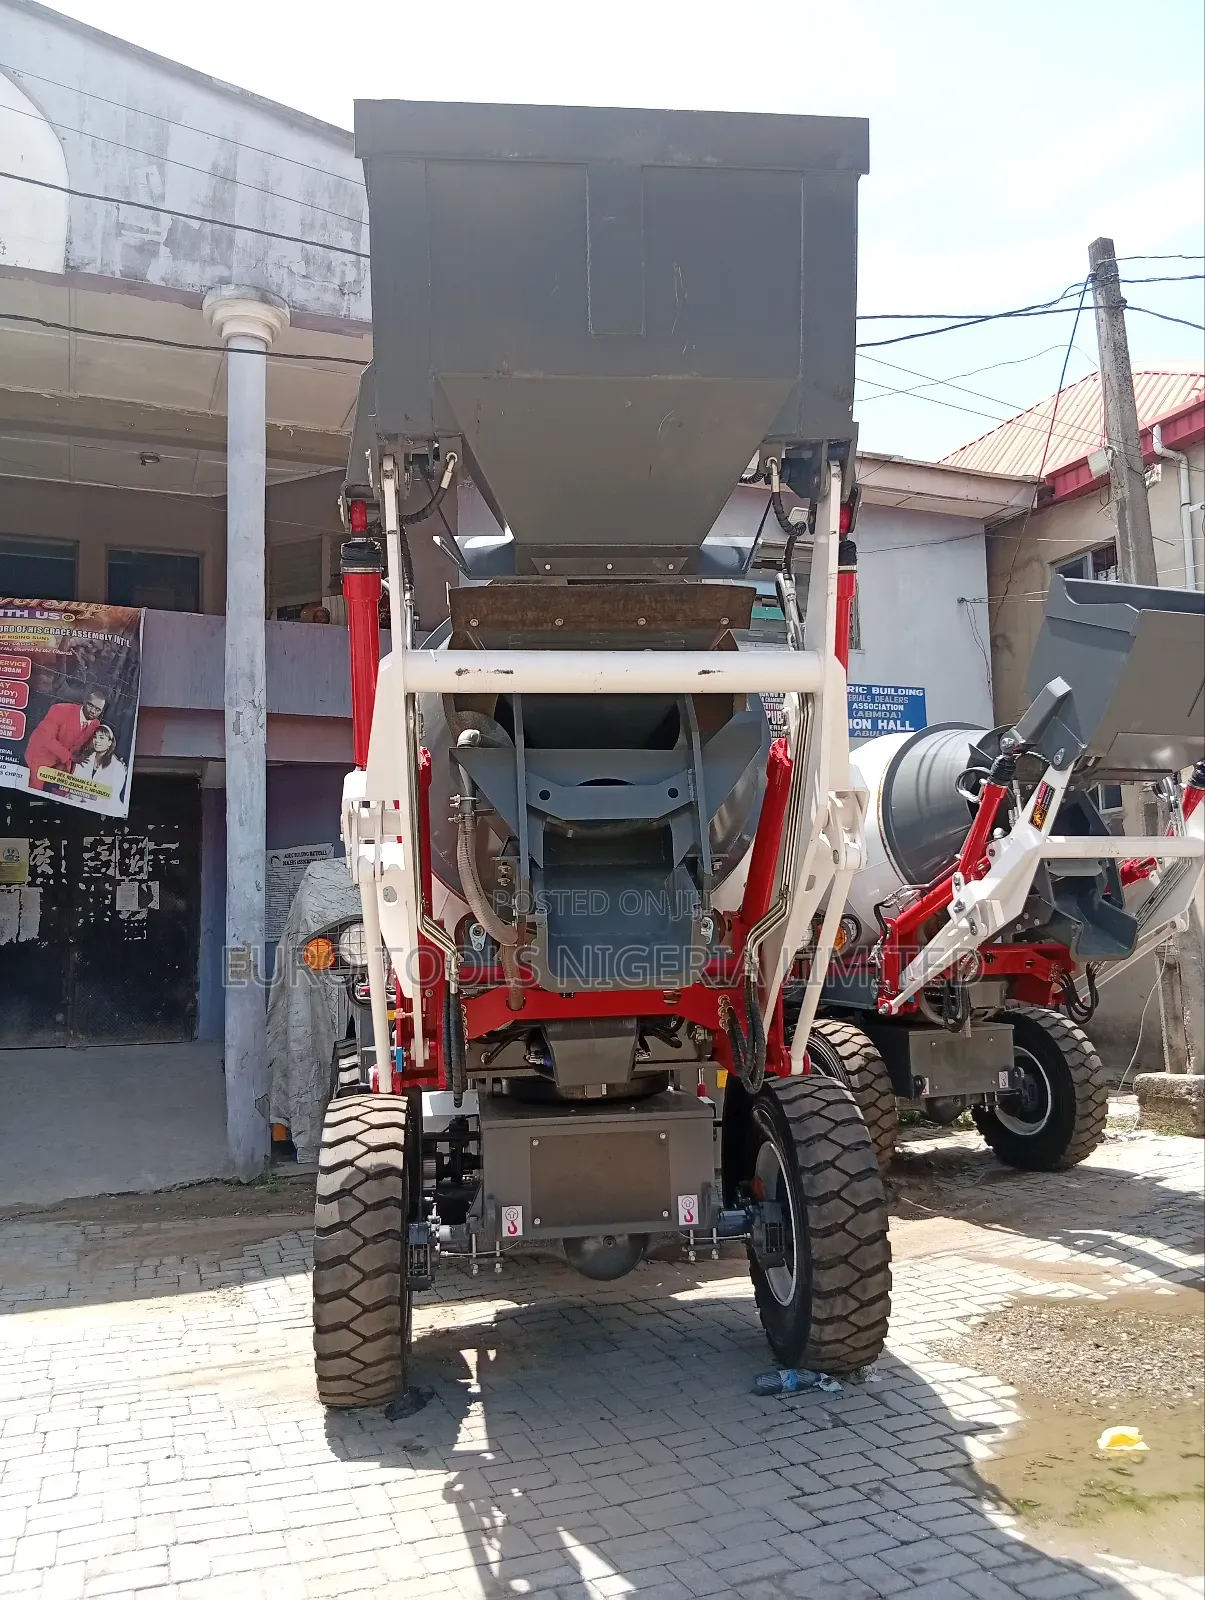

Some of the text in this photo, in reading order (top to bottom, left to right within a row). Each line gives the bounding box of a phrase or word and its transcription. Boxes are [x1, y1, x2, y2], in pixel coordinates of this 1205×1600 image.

[36, 611, 60, 620] US
[44, 628, 70, 636] GRACE
[72, 630, 113, 641] ASSEMBLY
[872, 687, 924, 696] BUILDING
[875, 696, 909, 704] DEALERS
[852, 703, 904, 711] ASSOCIATION
[853, 710, 902, 719] (ABMDA)
[878, 720, 914, 731] HALL
